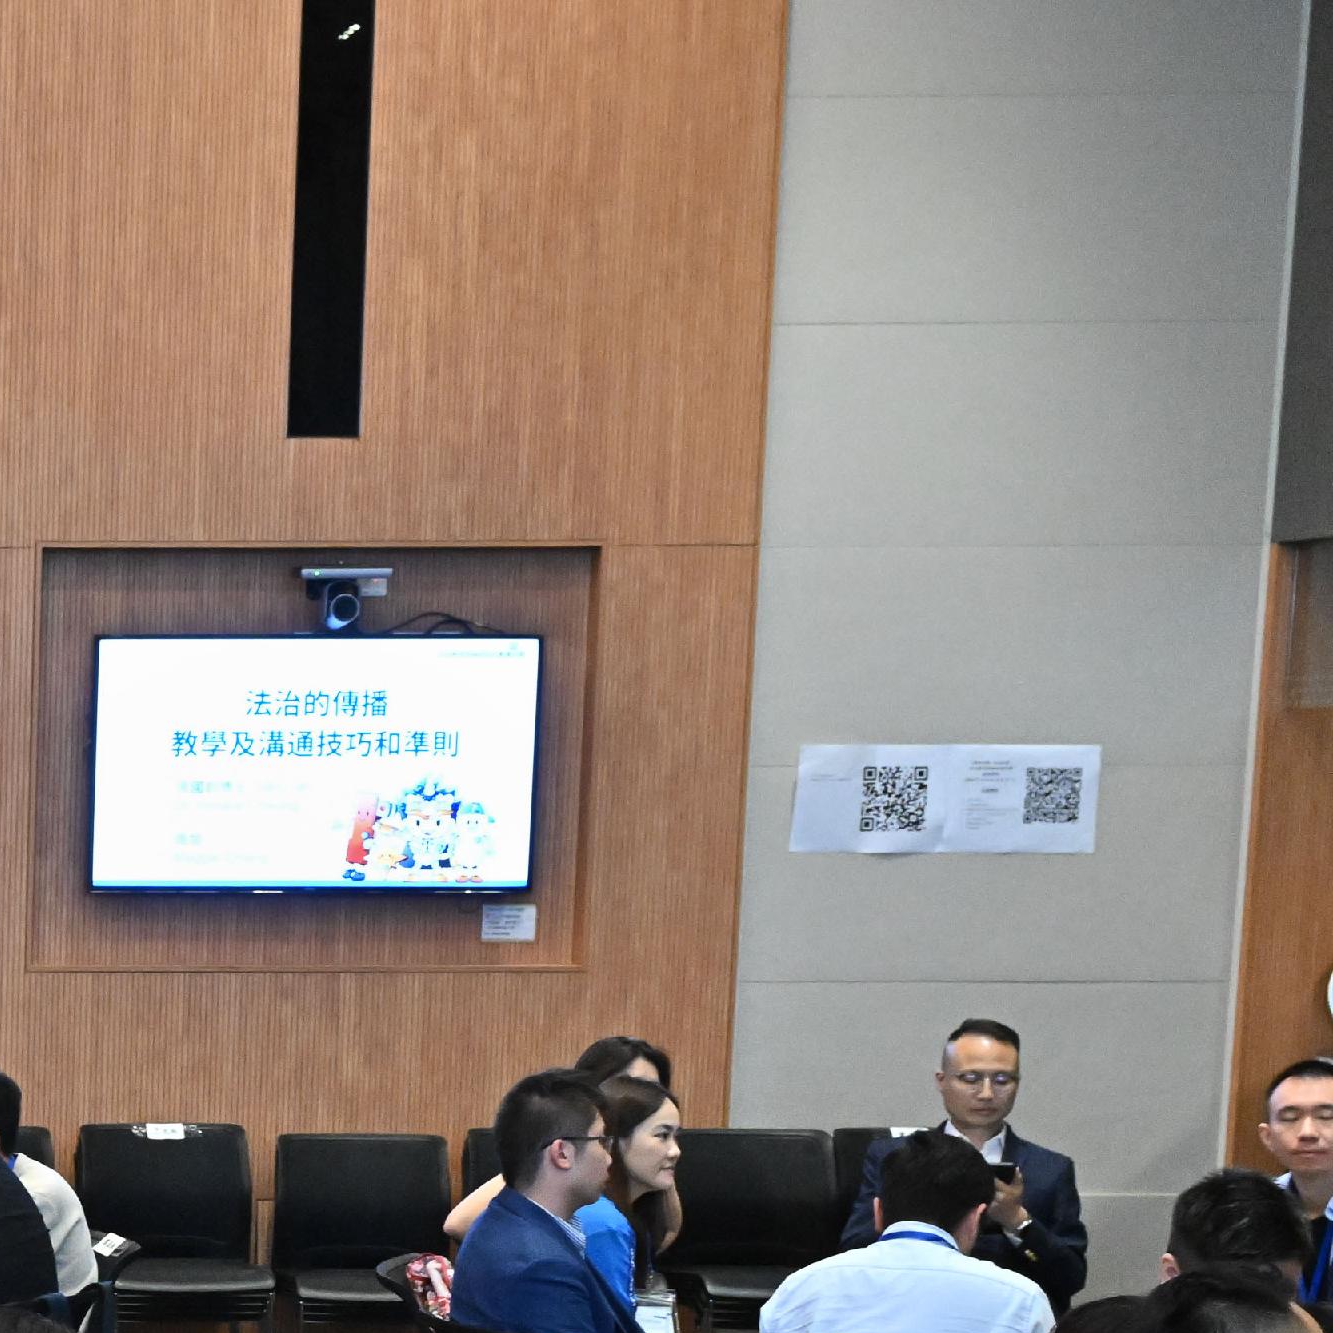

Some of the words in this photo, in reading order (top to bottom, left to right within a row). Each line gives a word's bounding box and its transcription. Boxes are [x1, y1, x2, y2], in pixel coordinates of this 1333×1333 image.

[245, 690, 389, 718] 法治的傳播
[171, 730, 460, 759] 教學及溝通技巧和準則
